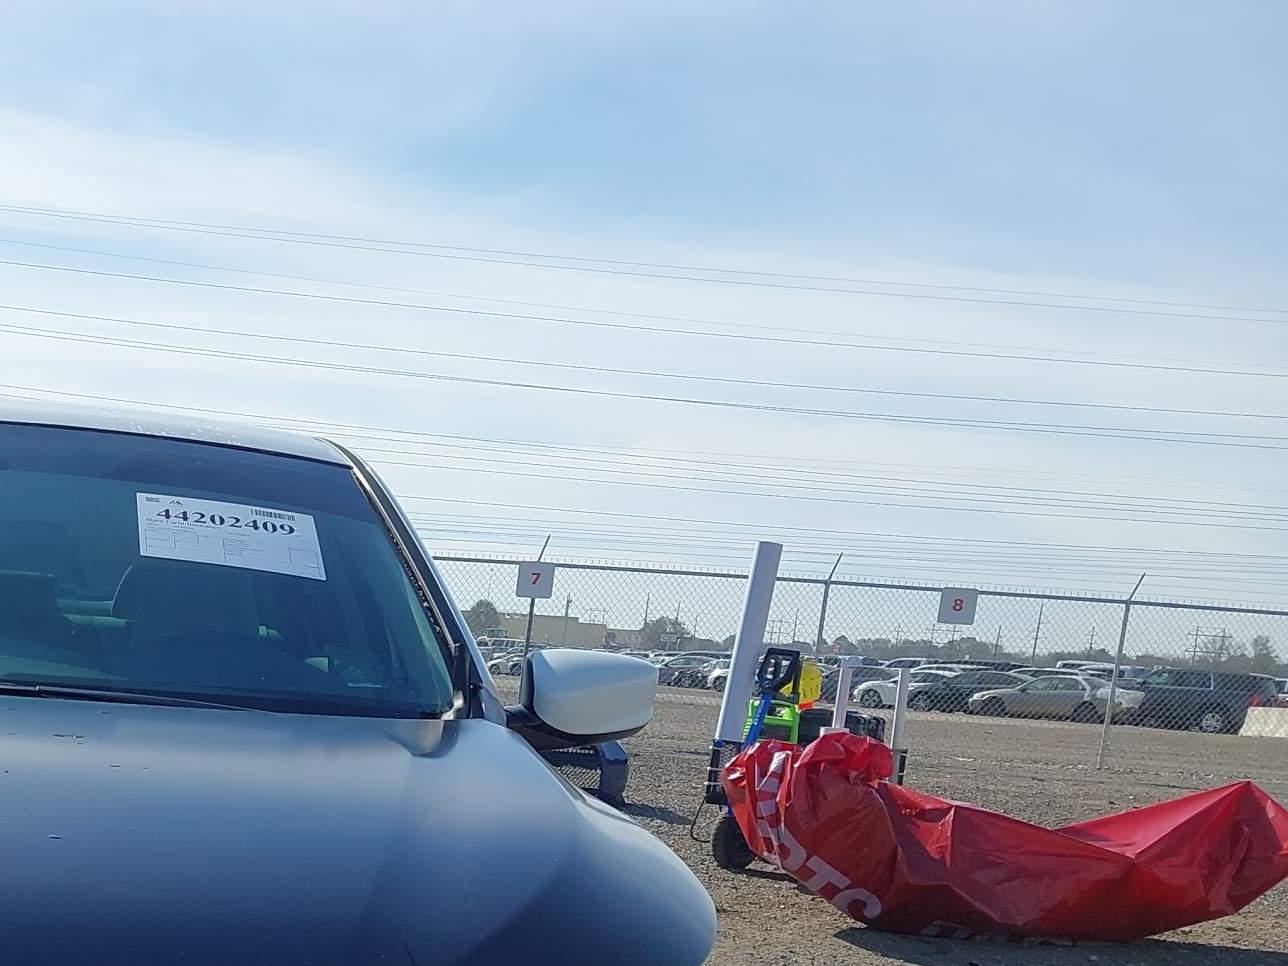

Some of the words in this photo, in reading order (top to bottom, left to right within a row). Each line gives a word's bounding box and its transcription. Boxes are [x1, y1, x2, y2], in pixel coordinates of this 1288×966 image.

[156, 508, 295, 536] 44202409
[531, 572, 542, 585] 7
[952, 598, 964, 612] 8
